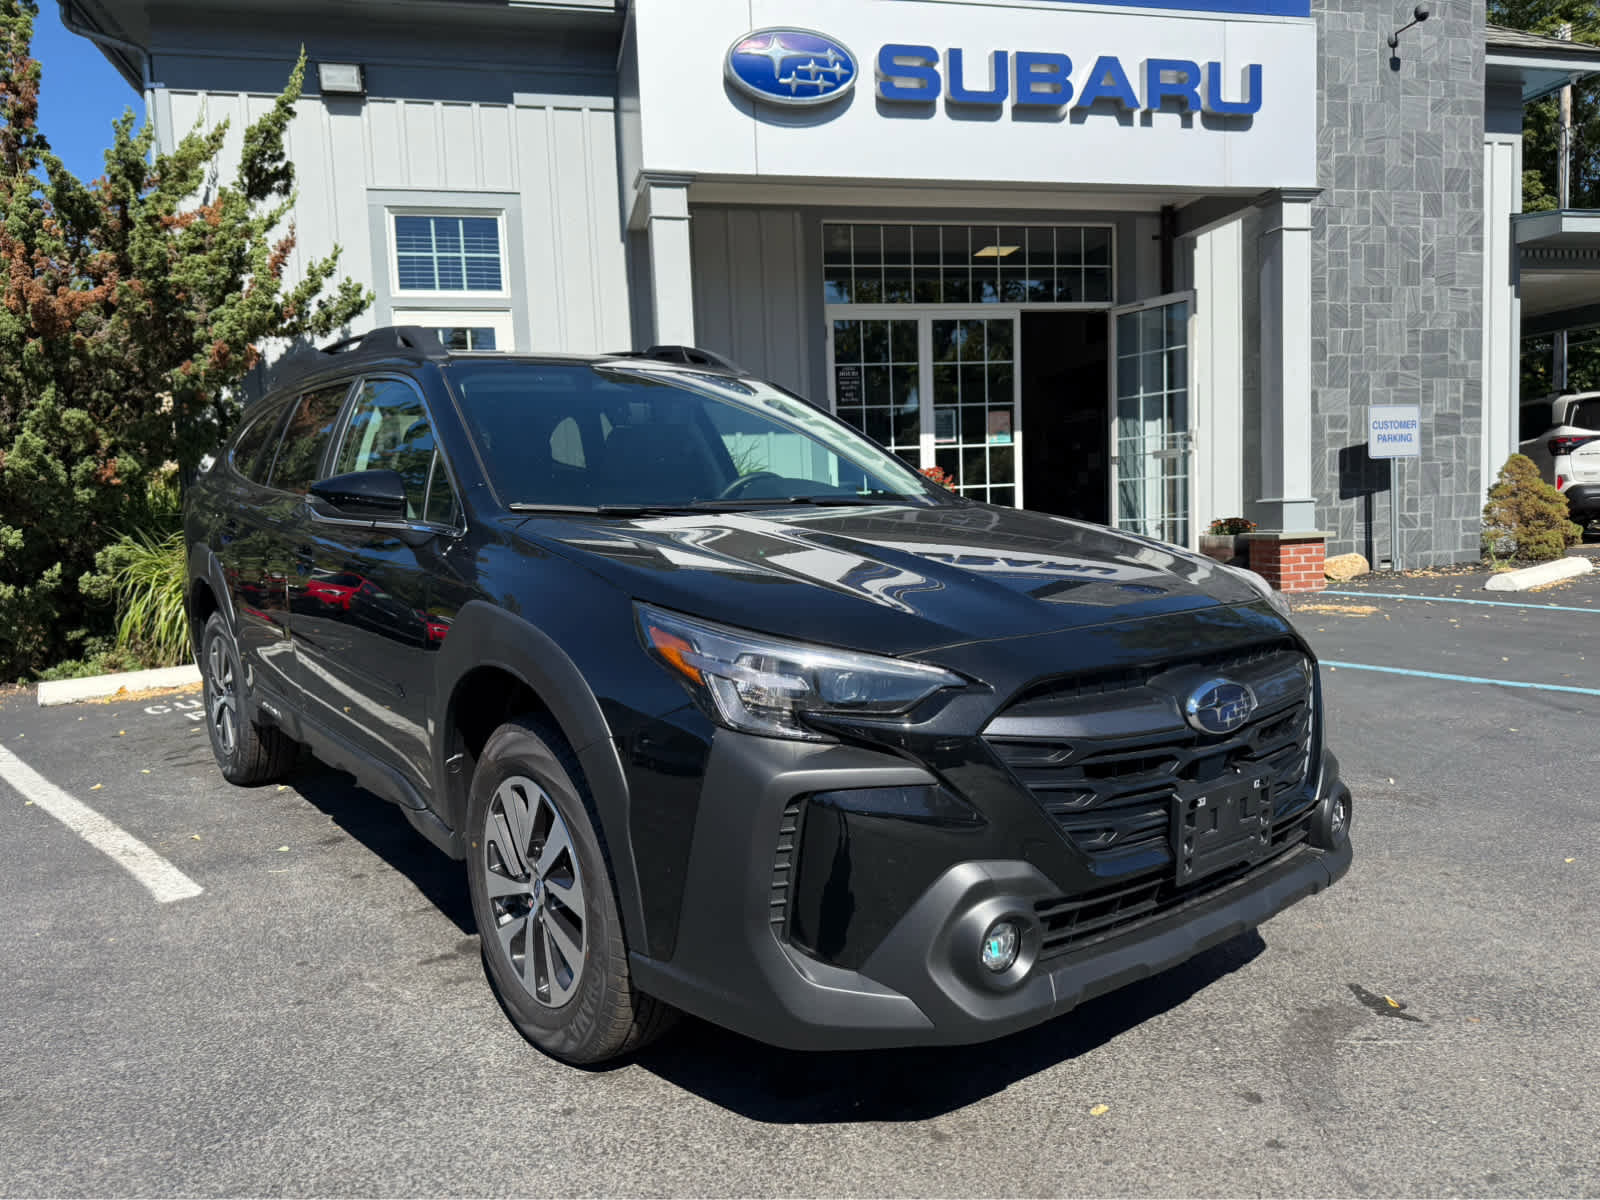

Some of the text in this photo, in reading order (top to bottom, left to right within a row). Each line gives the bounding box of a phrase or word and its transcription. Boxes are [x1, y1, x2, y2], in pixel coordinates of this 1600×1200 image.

[876, 43, 1262, 115] SUBARU
[1372, 420, 1417, 430] CUSTOMER
[1377, 433, 1413, 443] PARKING
